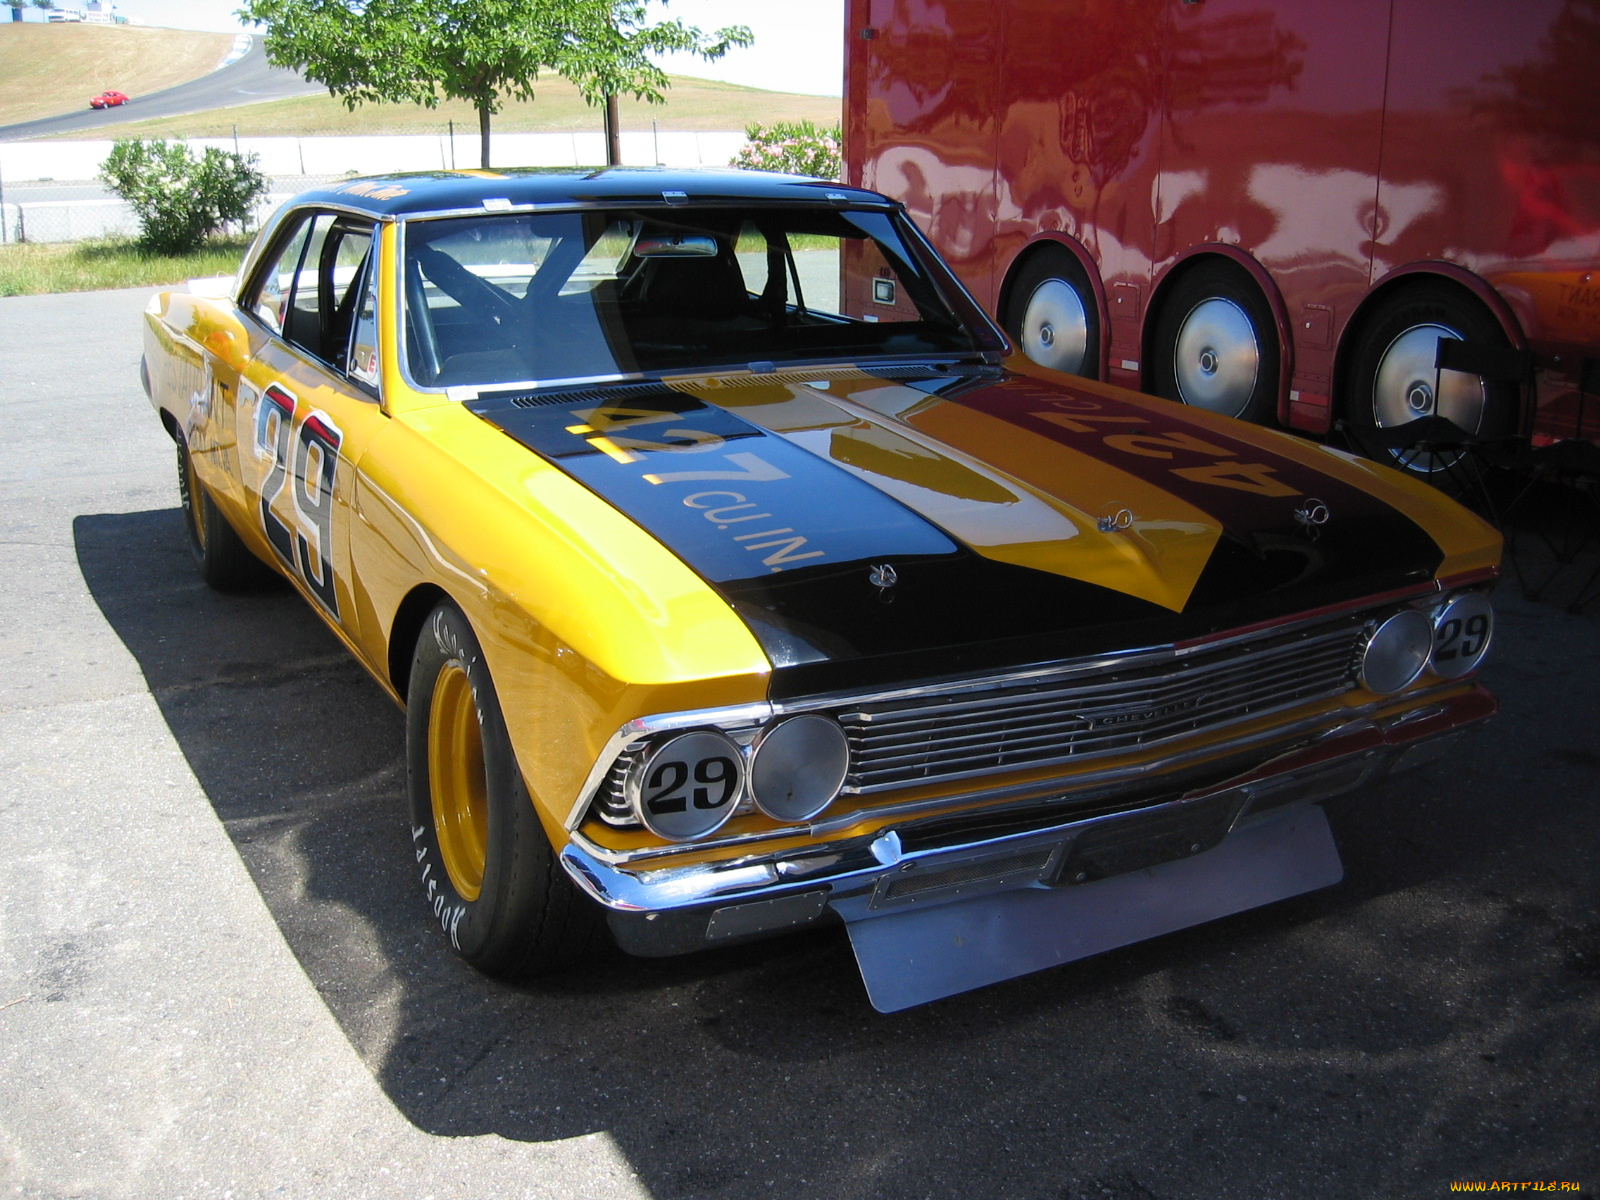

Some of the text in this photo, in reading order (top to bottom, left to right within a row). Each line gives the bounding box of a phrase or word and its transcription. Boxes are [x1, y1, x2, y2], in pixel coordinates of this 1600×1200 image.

[564, 407, 792, 485] 427
[1027, 411, 1304, 497] 427
[254, 381, 343, 623] 29
[1435, 614, 1488, 662] 29
[647, 756, 738, 815] 29
